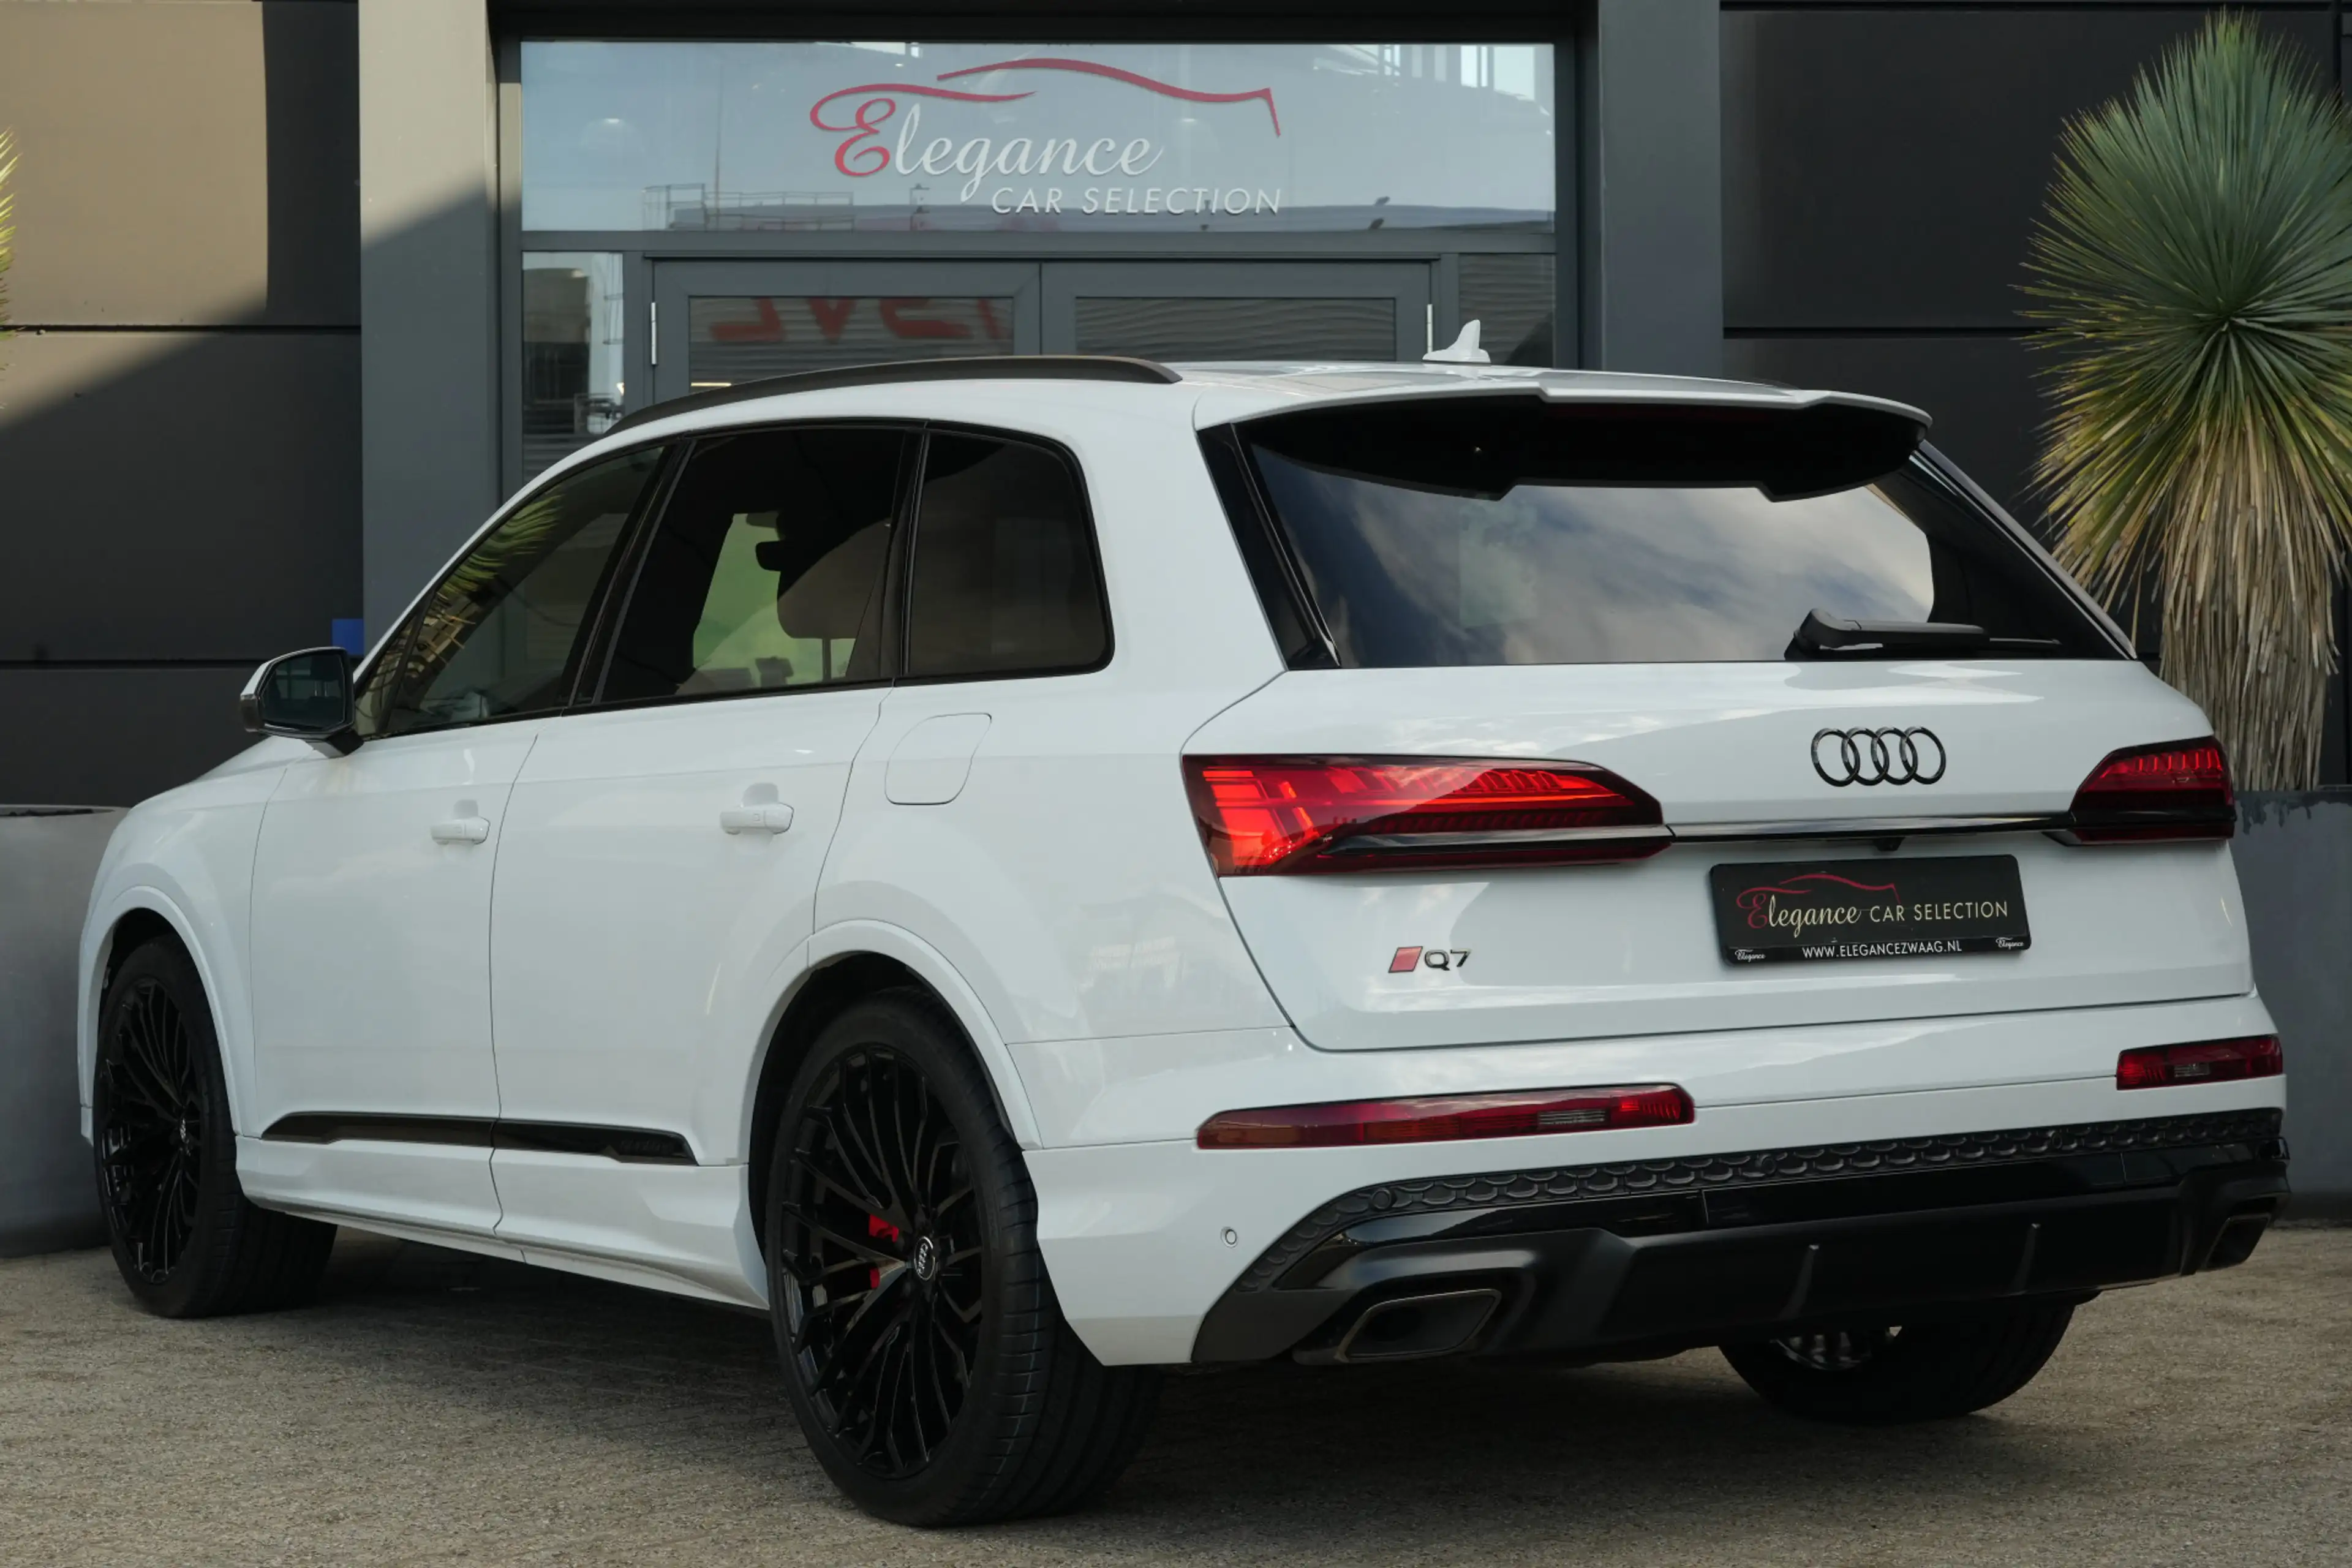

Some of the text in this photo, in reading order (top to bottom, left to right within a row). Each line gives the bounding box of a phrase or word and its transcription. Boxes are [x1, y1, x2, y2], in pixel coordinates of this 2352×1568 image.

[810, 83, 1164, 203] Elegance
[991, 187, 1282, 215] CAR SELECTION
[1736, 886, 2008, 938] Elegance CAR SELECTION
[1424, 949, 1471, 971] Q7
[1735, 949, 1766, 962] Elegance
[1802, 940, 1962, 959] WWW.ELEGANCEZWAAG.NL
